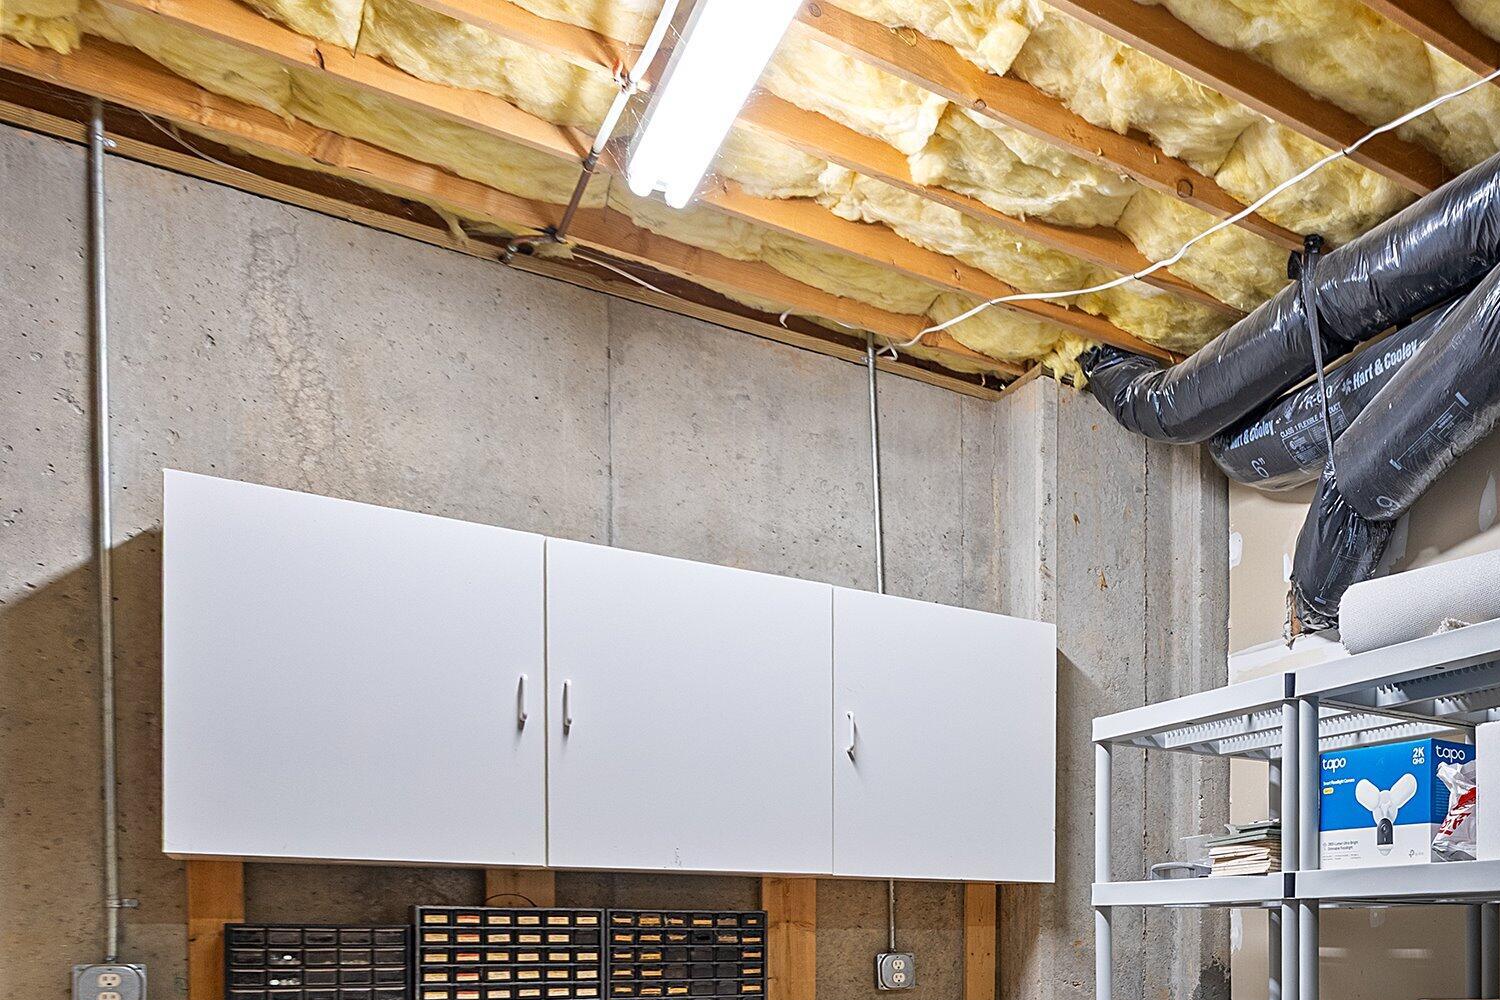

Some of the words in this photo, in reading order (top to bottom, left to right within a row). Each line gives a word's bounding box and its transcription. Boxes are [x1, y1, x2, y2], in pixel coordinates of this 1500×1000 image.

[1352, 365, 1374, 390] Hart
[1374, 358, 1384, 376] &
[1412, 746, 1425, 758] 2K
[1436, 745, 1466, 763] tapo
[1322, 757, 1347, 773] tapo
